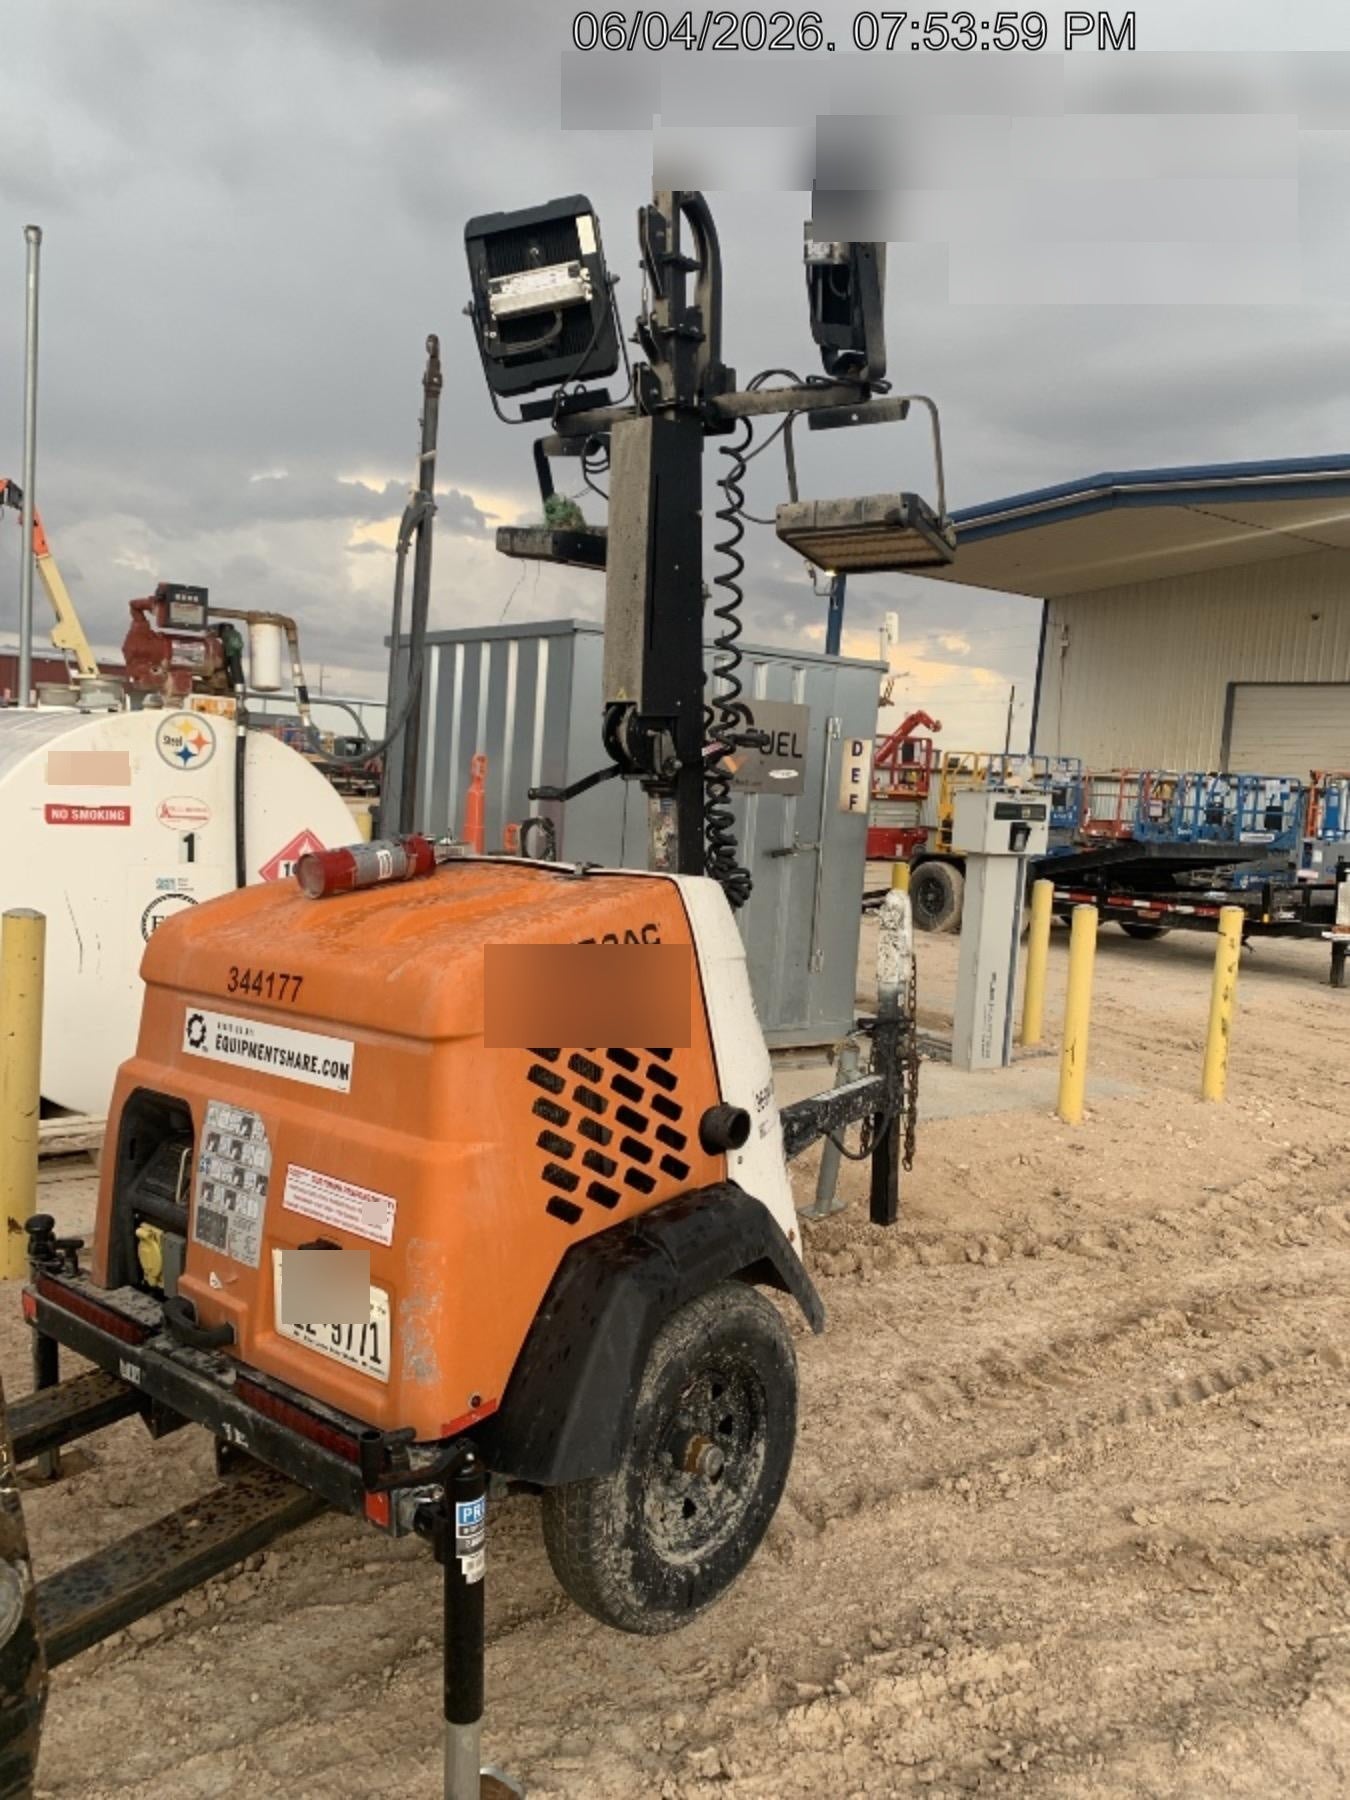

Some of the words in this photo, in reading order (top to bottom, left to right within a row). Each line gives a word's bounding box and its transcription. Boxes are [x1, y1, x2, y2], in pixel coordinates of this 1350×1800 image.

[51, 808, 69, 820] NO
[71, 809, 125, 821] SMOKING
[183, 832, 195, 863] 1
[227, 966, 303, 1003] 344177
[215, 1034, 350, 1081] EQUIPMENTSHARE.COM
